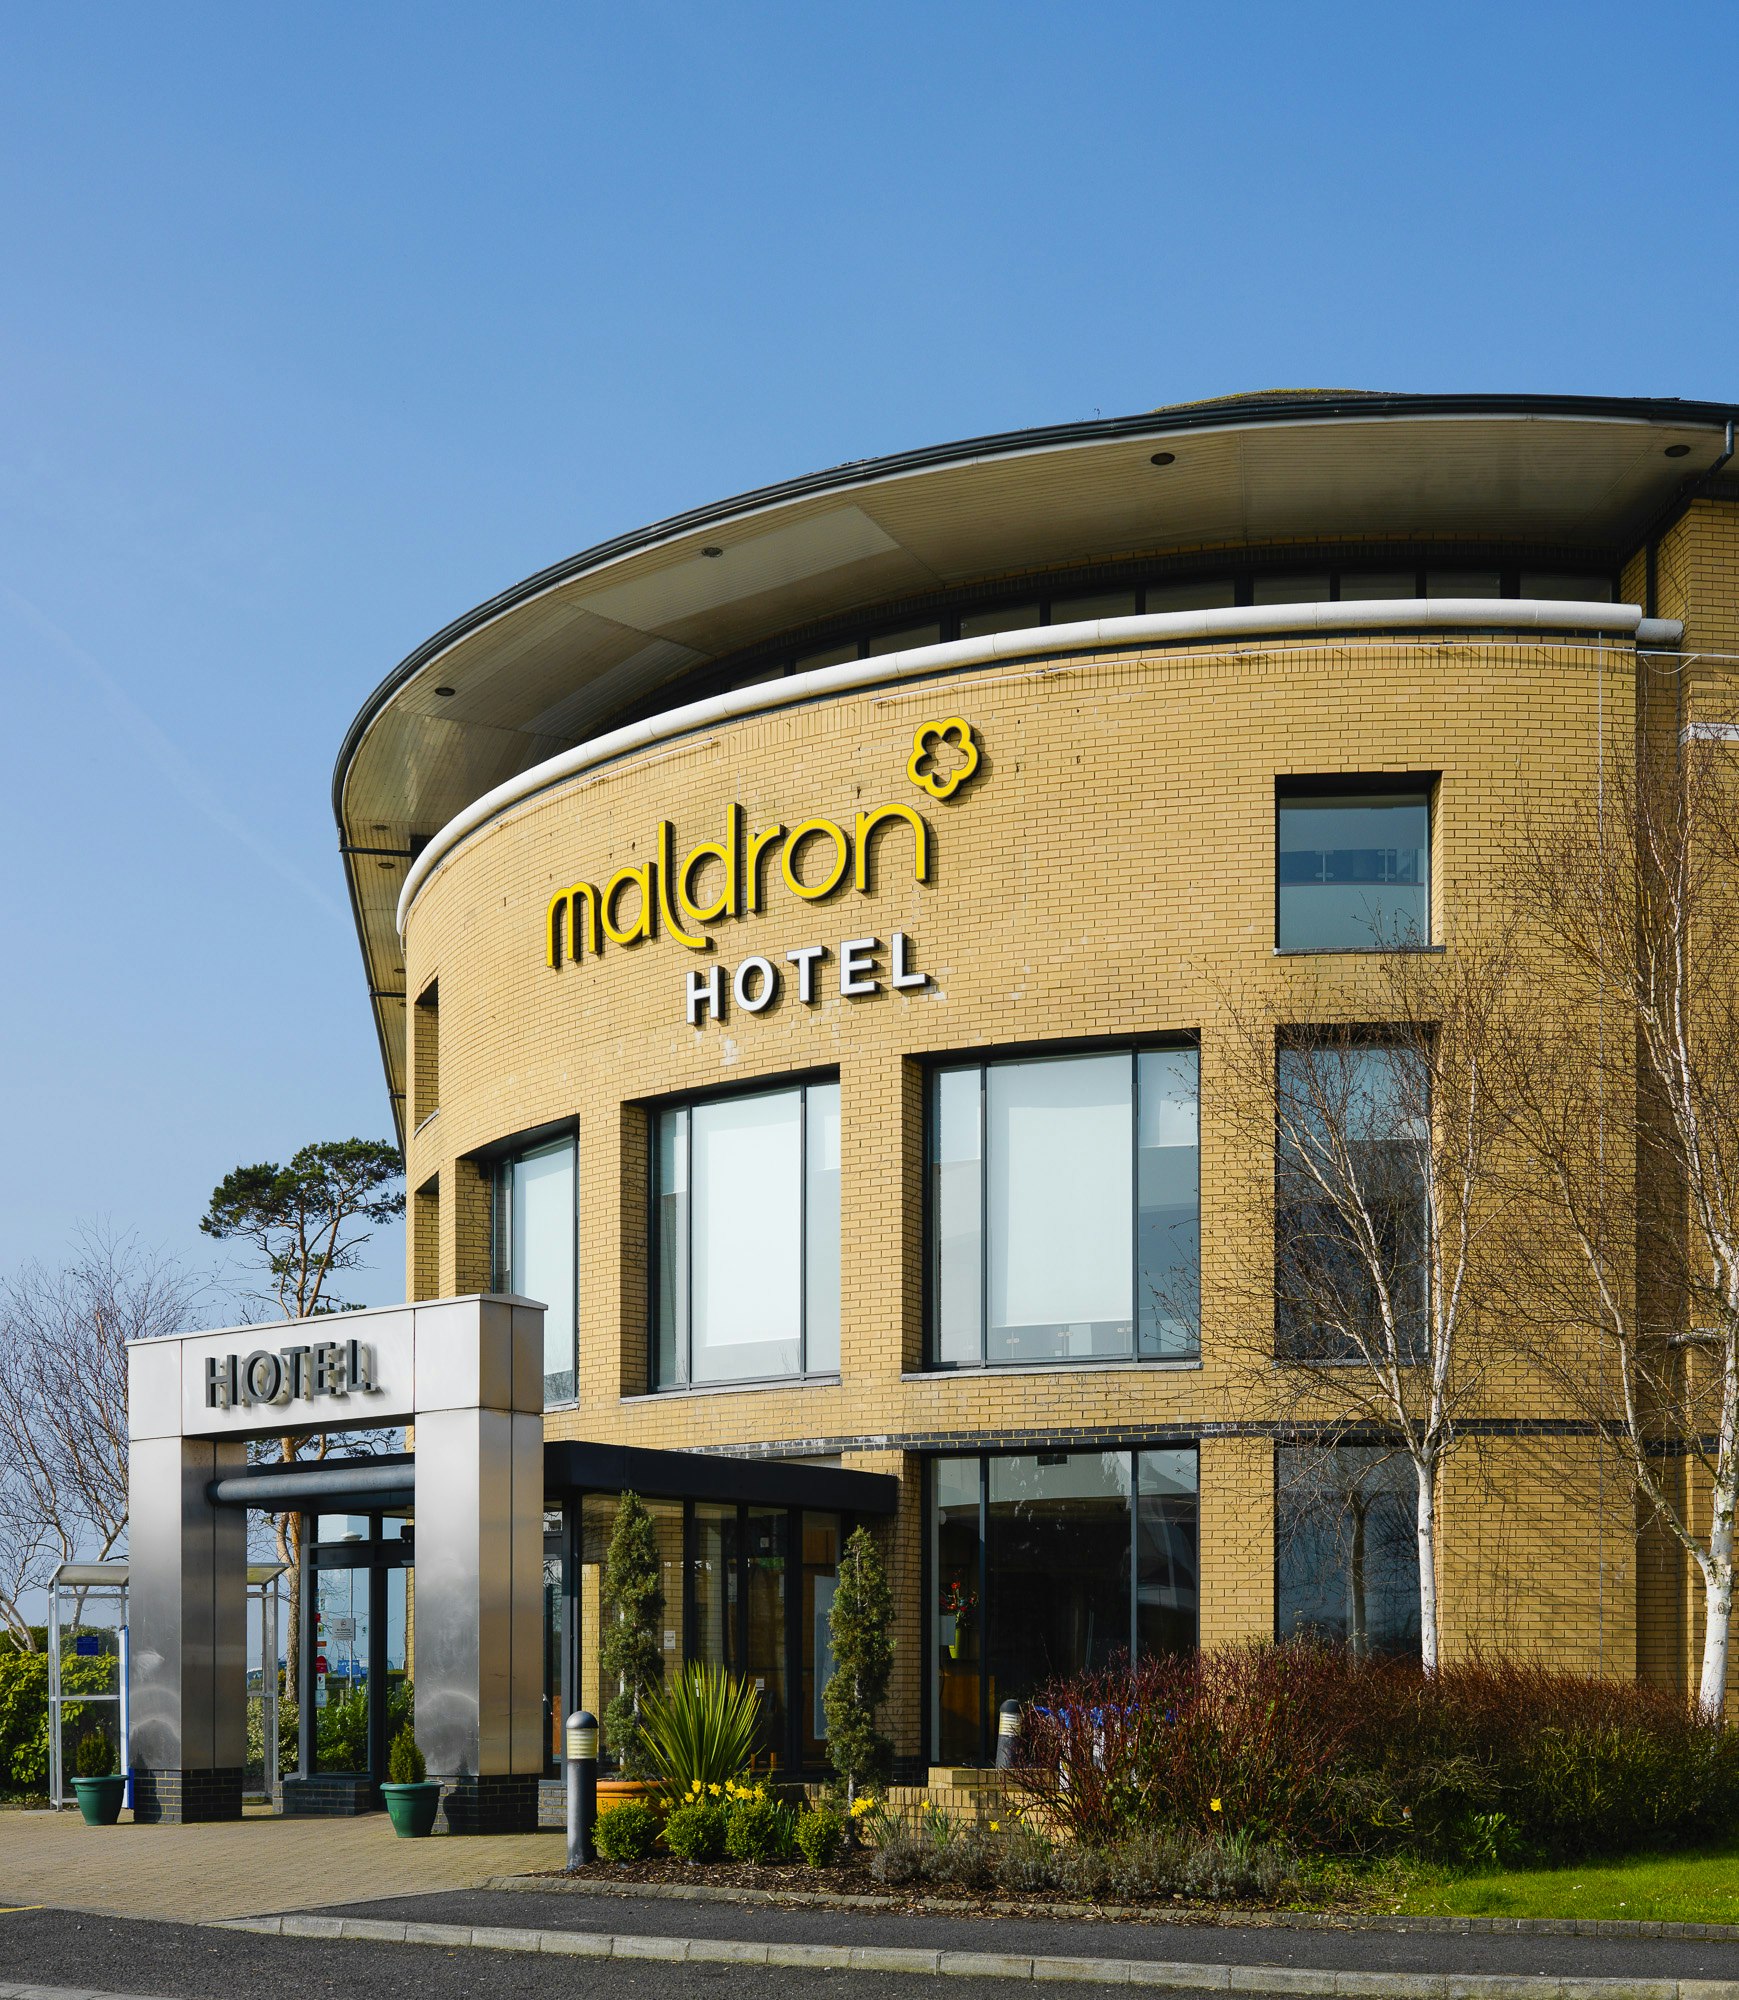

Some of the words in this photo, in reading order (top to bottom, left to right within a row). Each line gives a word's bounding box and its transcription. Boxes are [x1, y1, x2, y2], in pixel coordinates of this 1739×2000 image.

[546, 802, 929, 969] maldron
[686, 932, 928, 1026] HOTEL
[205, 1339, 376, 1409] HOTEL
